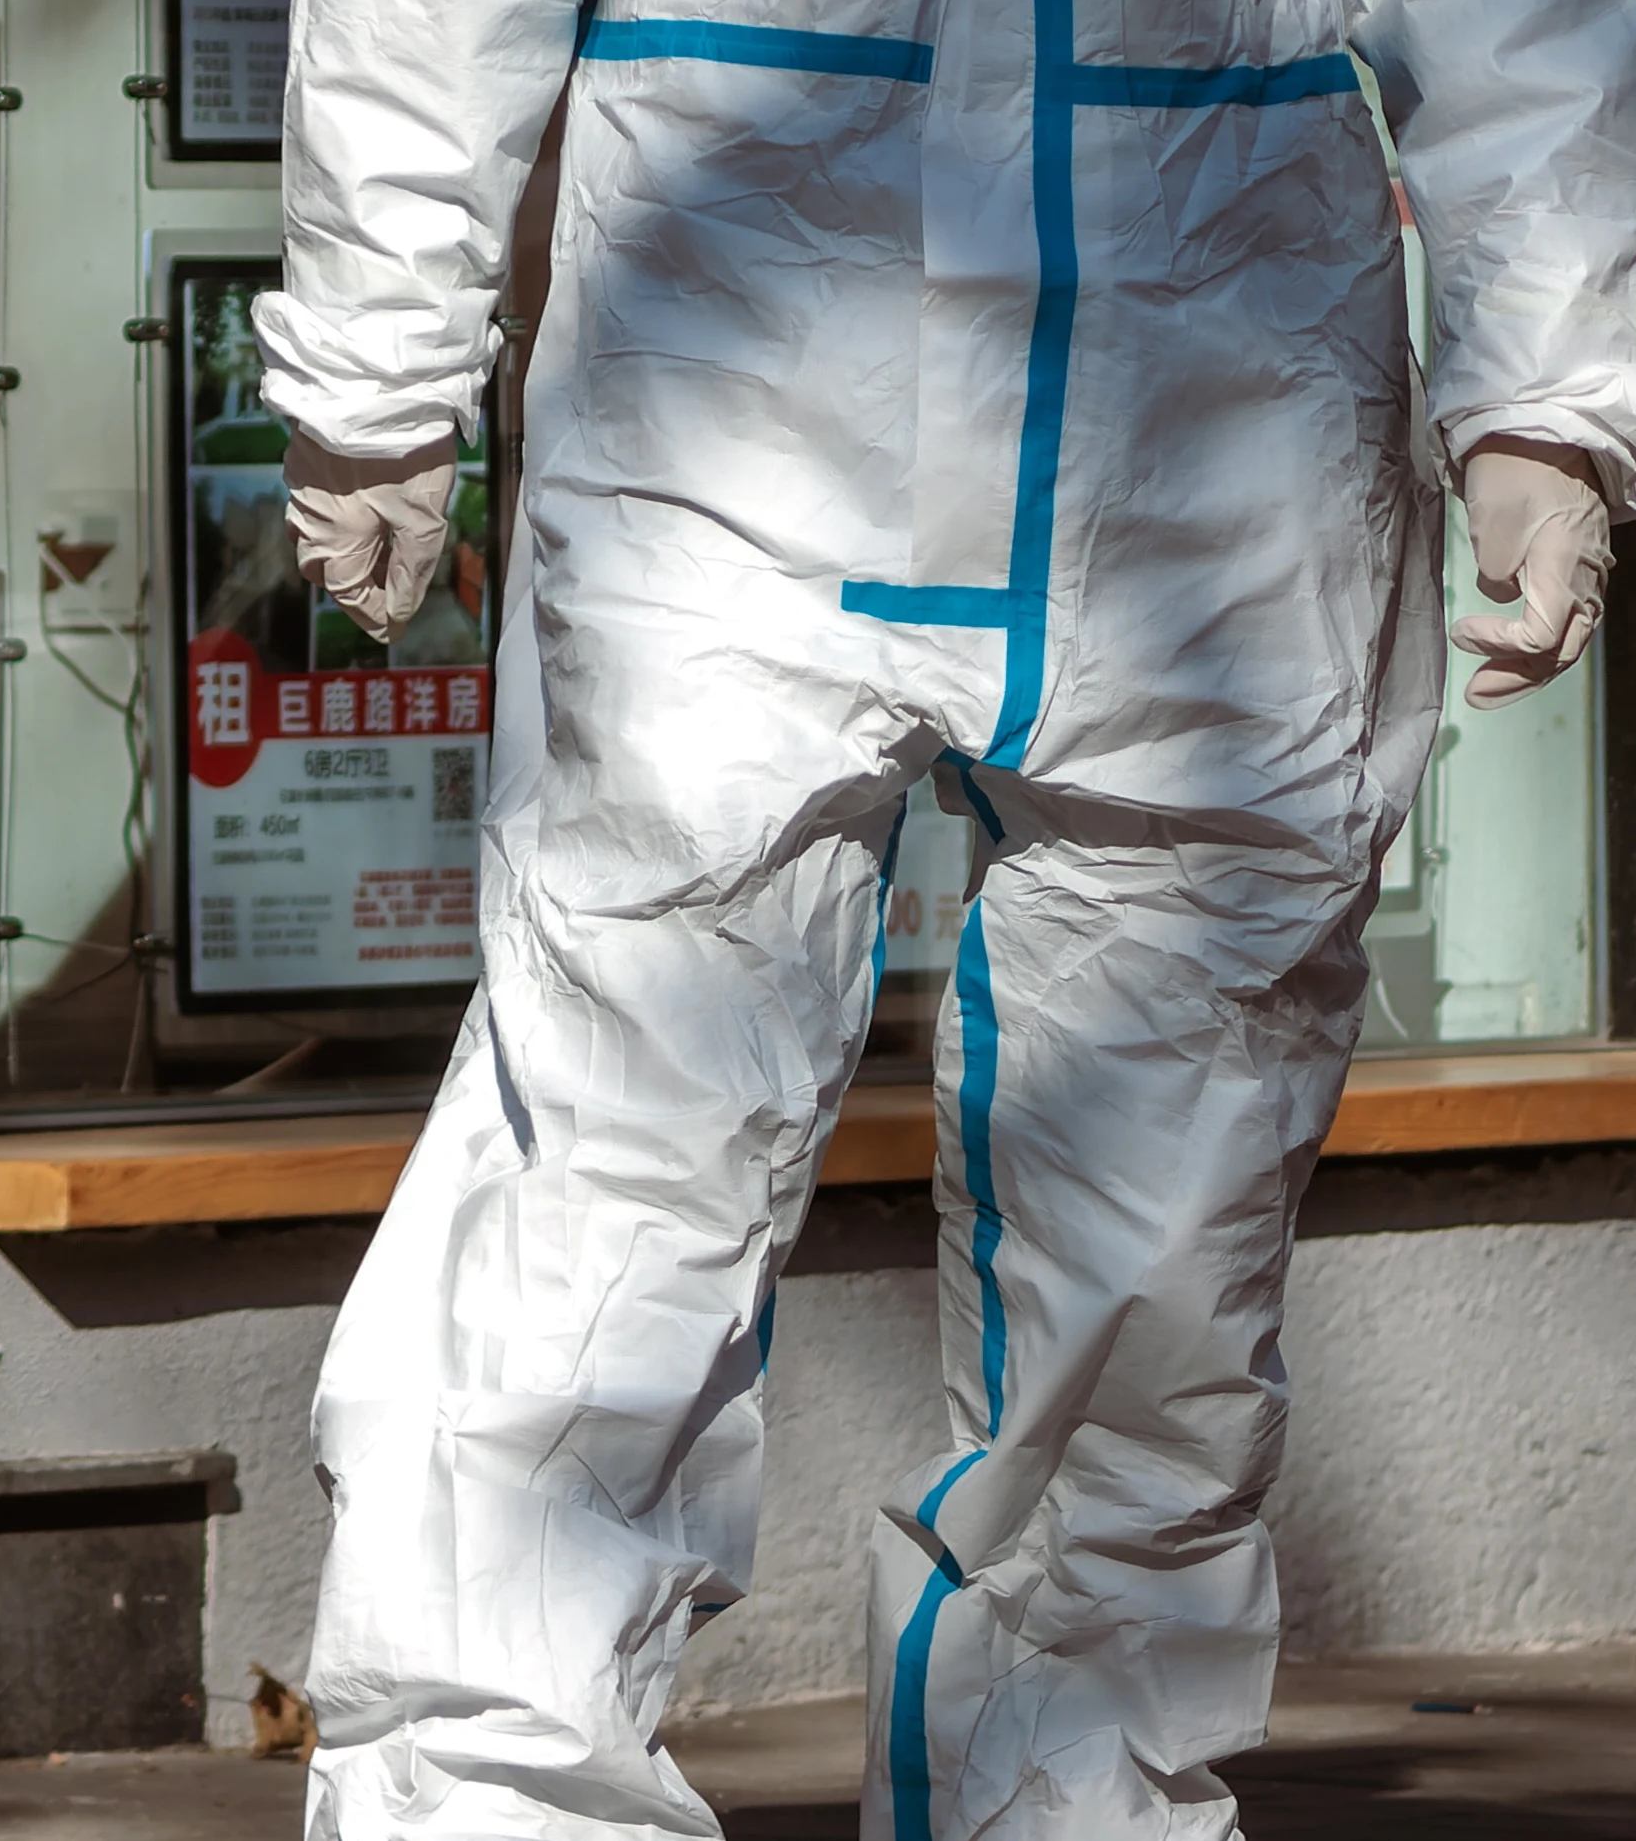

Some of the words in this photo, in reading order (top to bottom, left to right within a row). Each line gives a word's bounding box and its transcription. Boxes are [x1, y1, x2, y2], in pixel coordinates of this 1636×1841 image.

[196, 661, 251, 747] 租
[277, 676, 481, 733] 巨鹿路洋房
